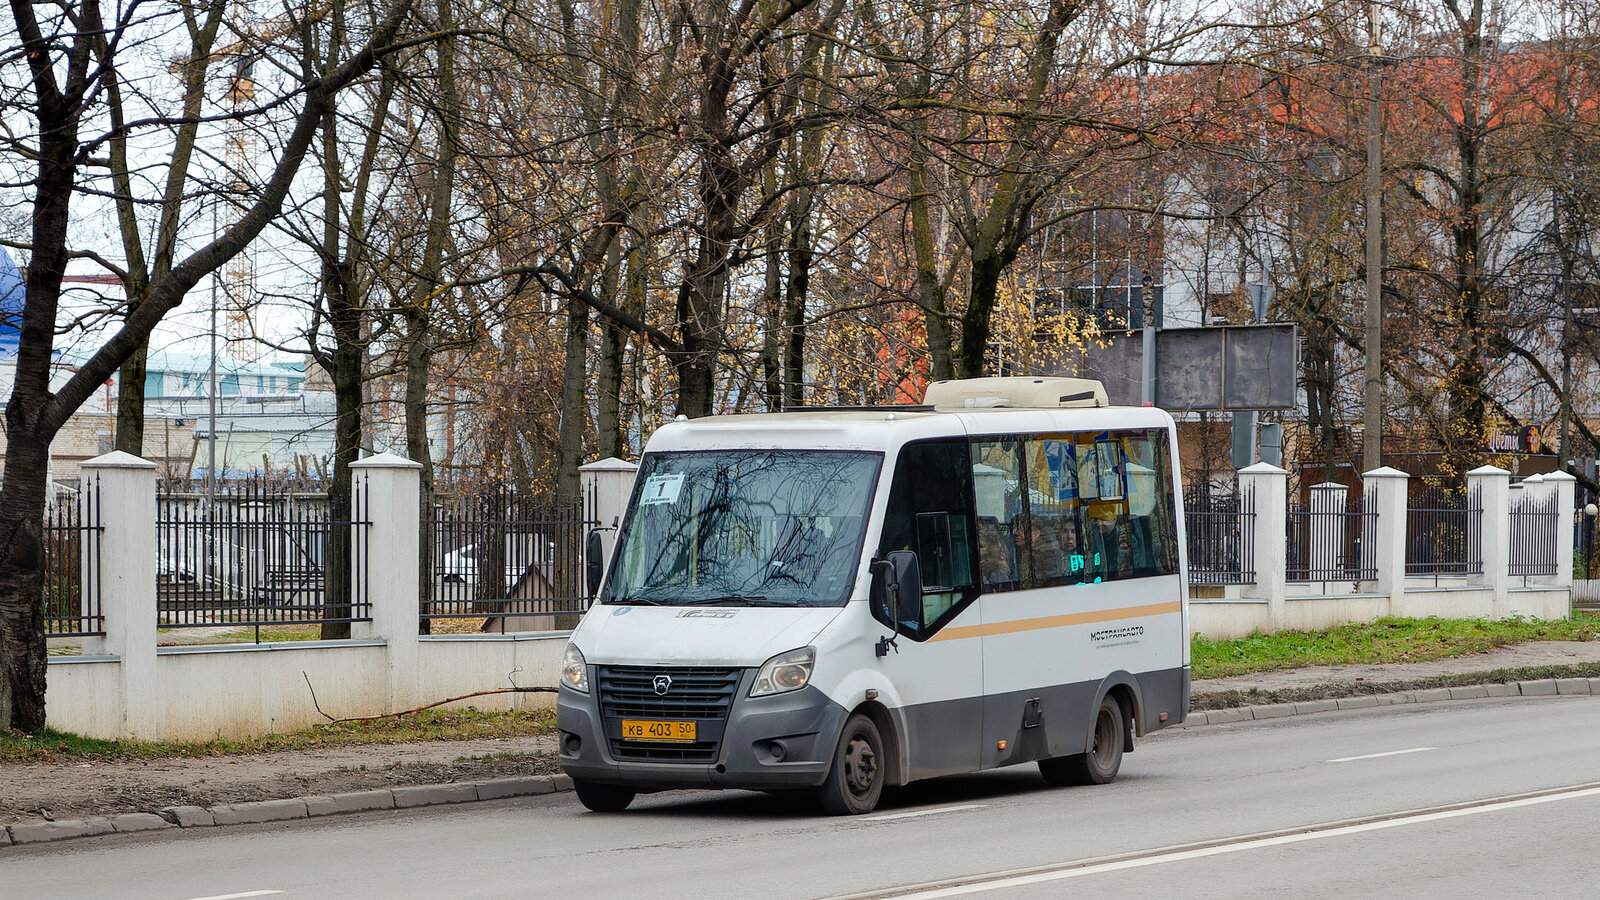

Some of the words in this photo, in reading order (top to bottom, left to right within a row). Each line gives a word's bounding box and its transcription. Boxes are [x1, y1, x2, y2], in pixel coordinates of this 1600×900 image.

[657, 482, 666, 497] 1
[1090, 626, 1144, 641] МОСТРАНСАВТО
[628, 725, 643, 736] КВ
[649, 723, 672, 736] 403
[678, 723, 692, 734] 50
